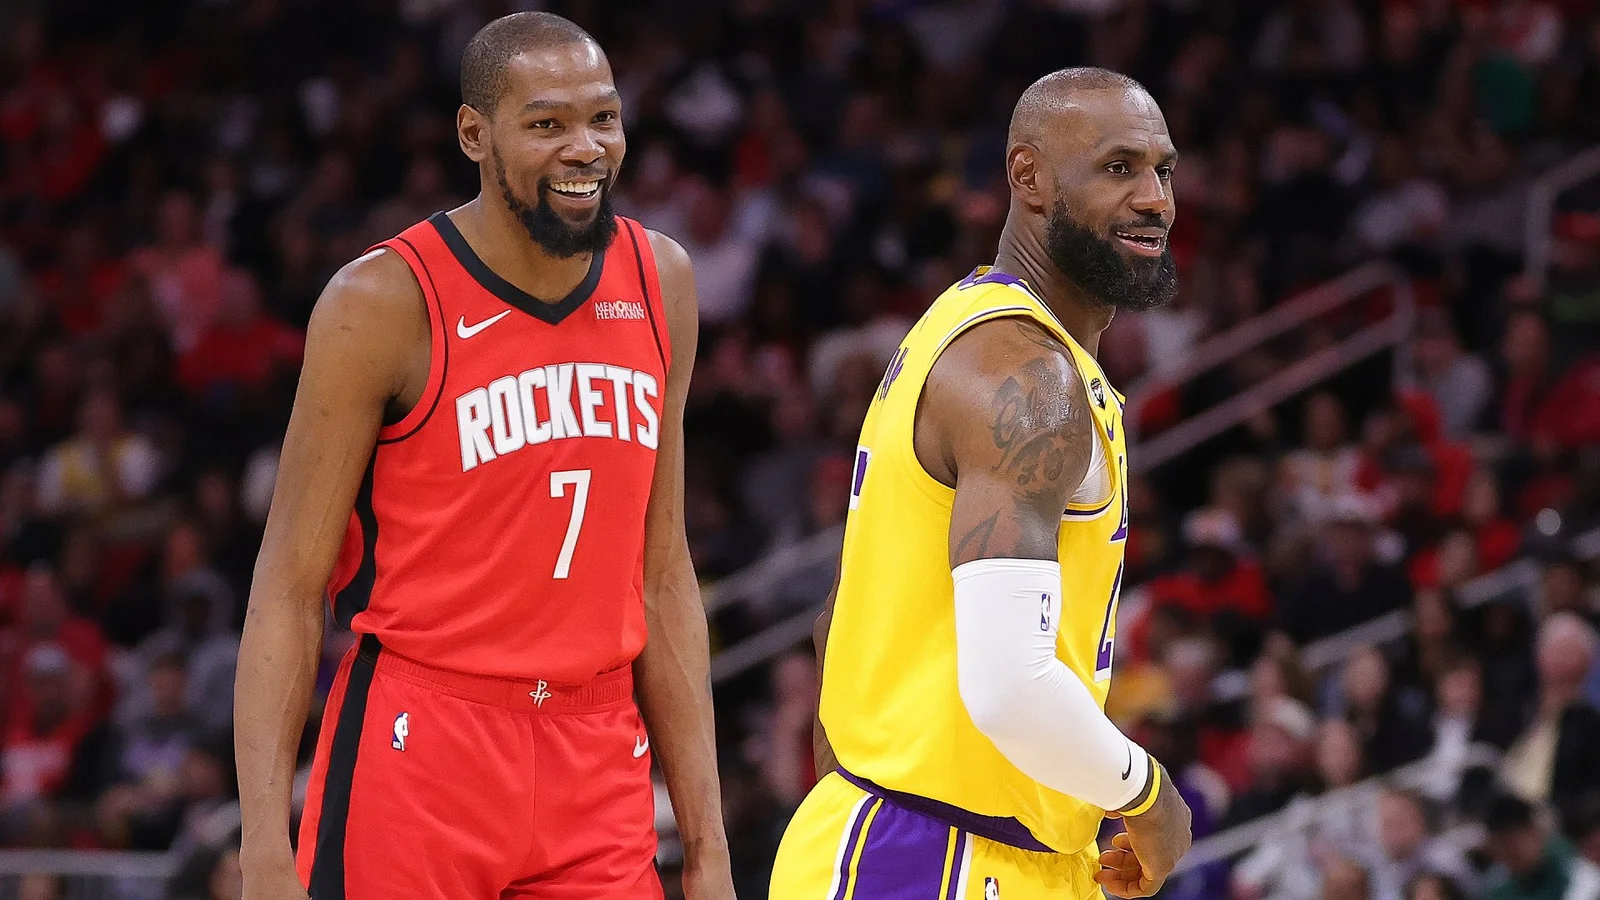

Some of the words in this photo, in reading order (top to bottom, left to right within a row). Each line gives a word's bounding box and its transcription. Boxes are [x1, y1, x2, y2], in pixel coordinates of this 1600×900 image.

[594, 300, 642, 311] MEMORIAL
[595, 308, 645, 320] HERMANN
[456, 362, 658, 473] ROCKETS
[550, 469, 592, 579] 7
